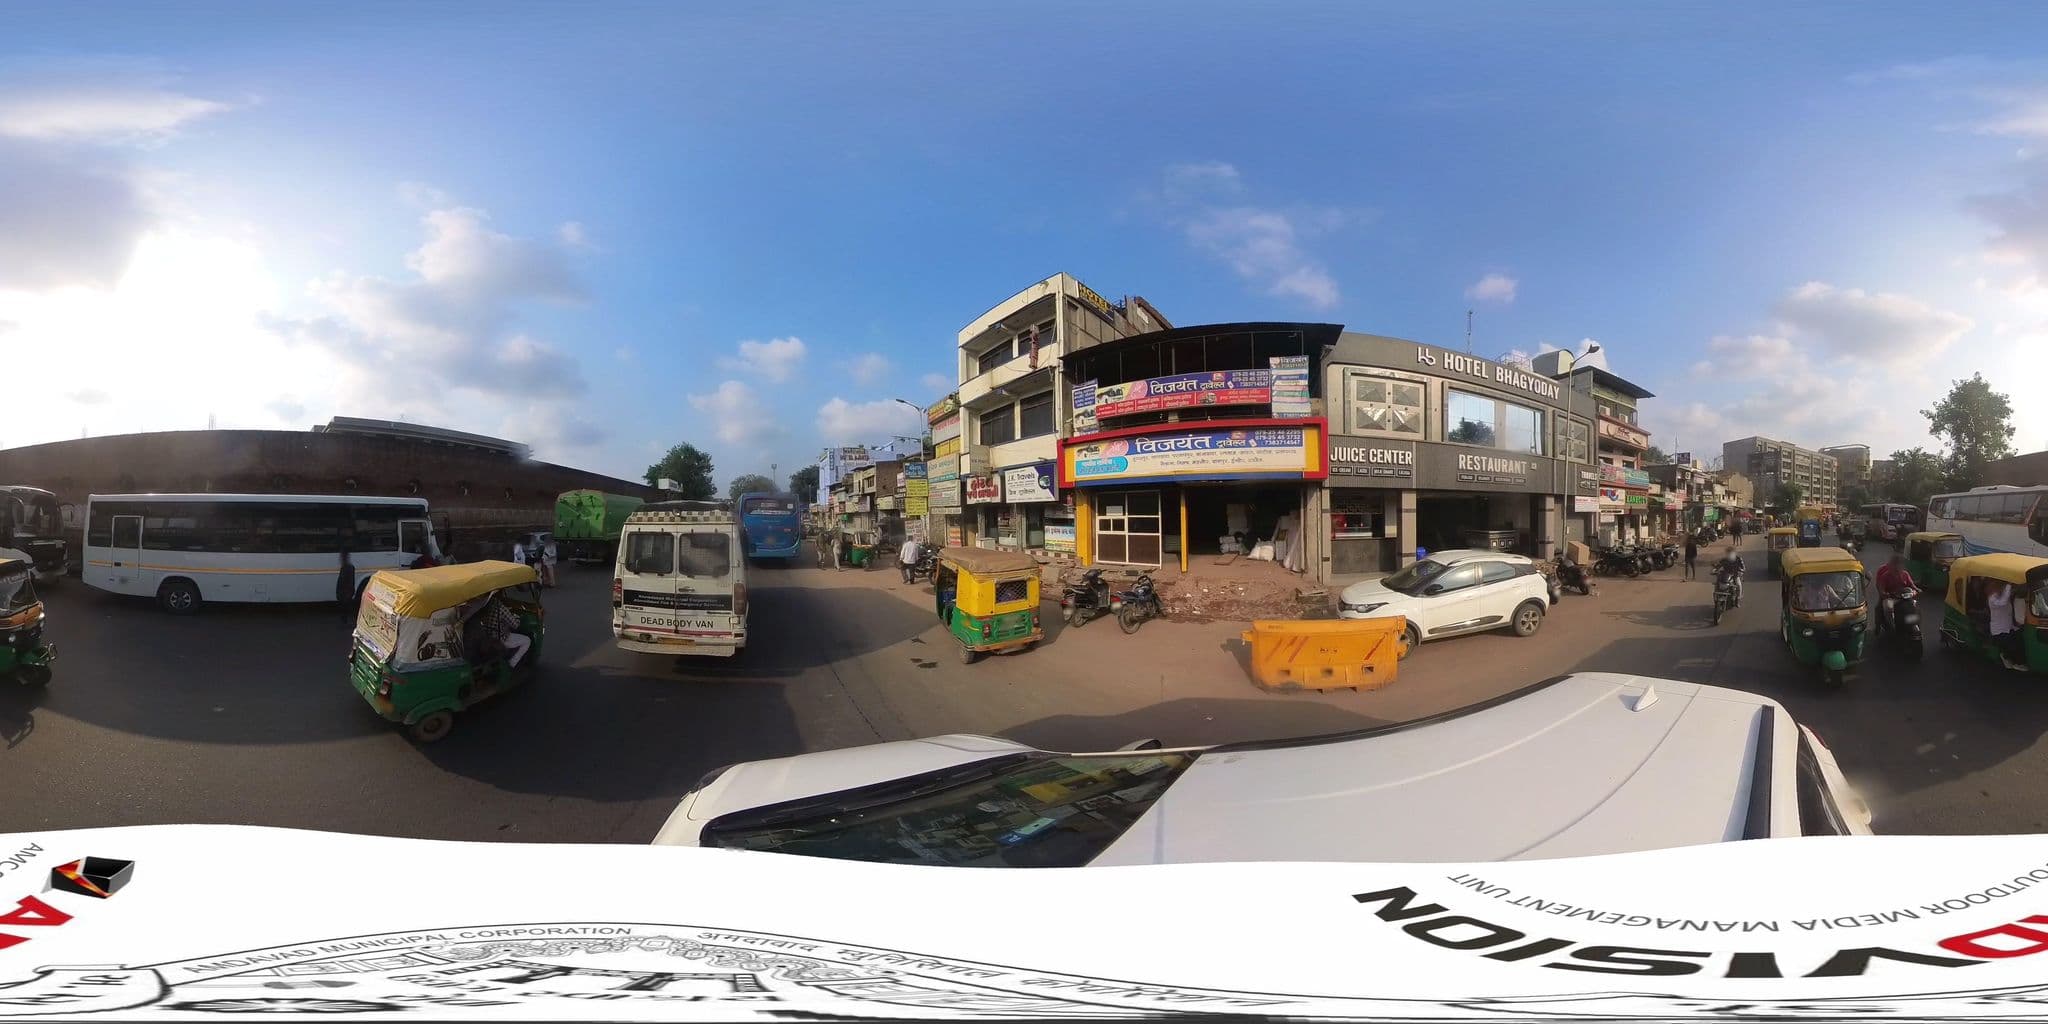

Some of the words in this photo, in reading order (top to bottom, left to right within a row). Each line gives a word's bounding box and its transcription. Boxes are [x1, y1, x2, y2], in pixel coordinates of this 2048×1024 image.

[1443, 352, 1489, 379] HOTEL
[1495, 366, 1560, 400] BHAGYODAY
[1150, 378, 1198, 394] विजयंत
[1135, 434, 1212, 453] विजयंत
[1330, 446, 1366, 462] JUICE
[1369, 448, 1412, 465] CENTER
[1458, 454, 1527, 474] RESTAURANT
[640, 616, 664, 626] DEAD
[666, 618, 692, 628] BODY
[695, 620, 714, 628] VAN
